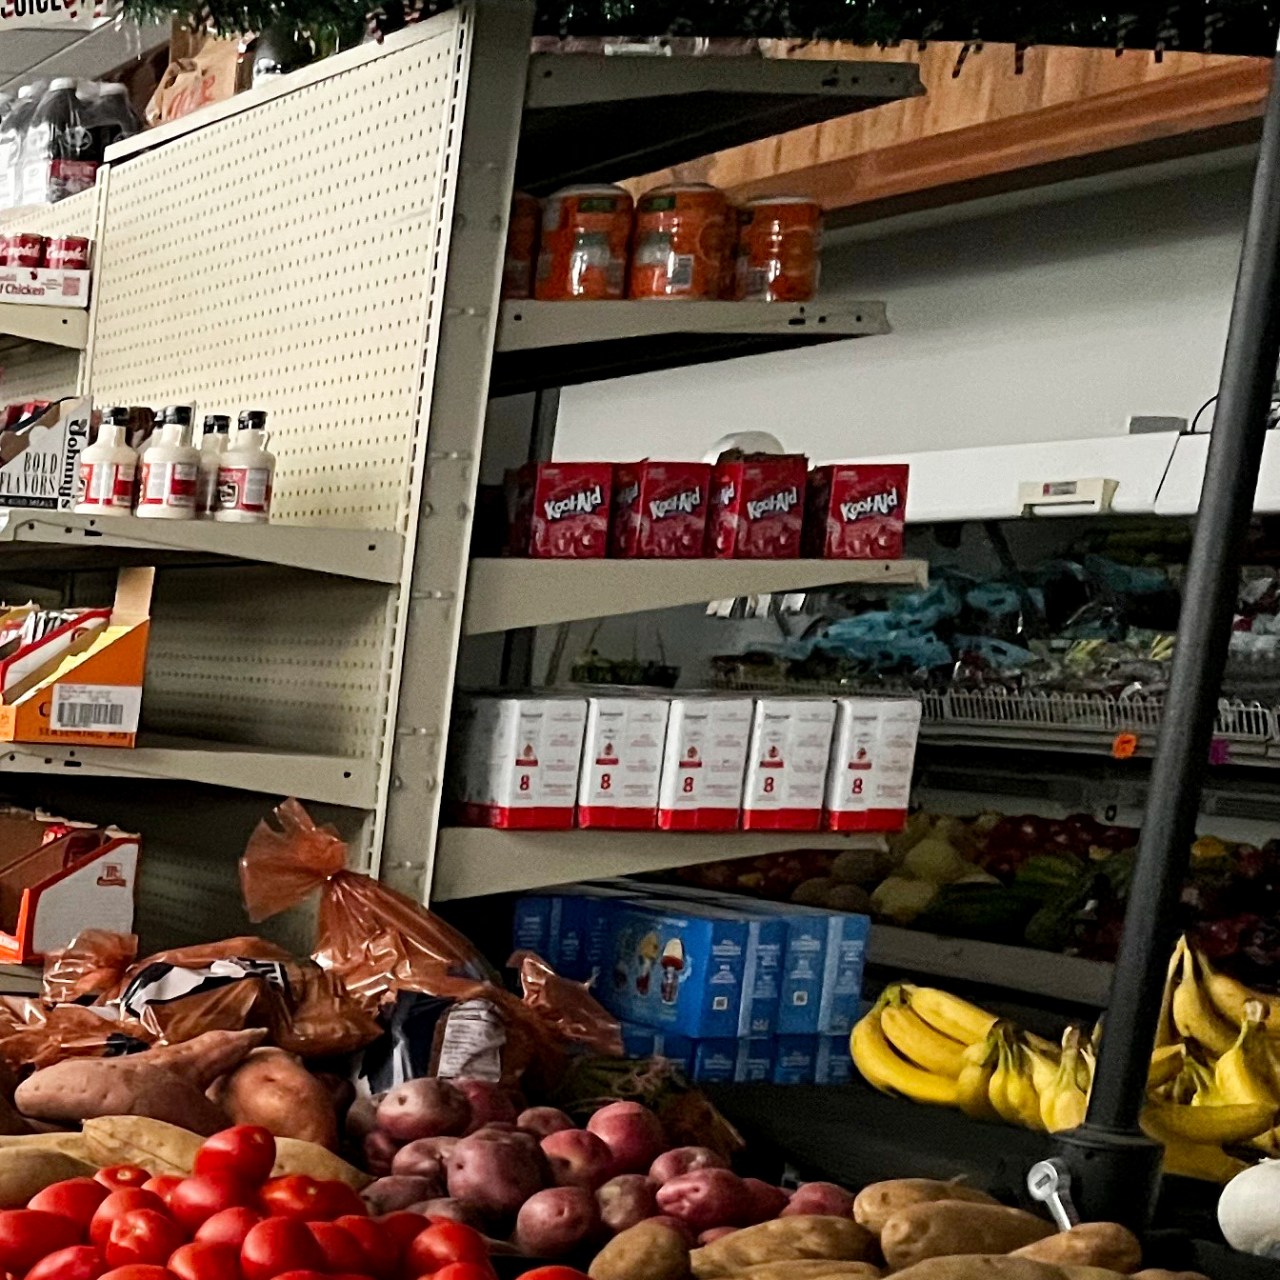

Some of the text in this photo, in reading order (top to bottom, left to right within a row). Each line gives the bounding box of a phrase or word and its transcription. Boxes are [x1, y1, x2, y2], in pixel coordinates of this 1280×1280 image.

[6, 282, 45, 296] Chicken
[24, 452, 58, 474] BOLD
[59, 418, 89, 511] Johnny's
[544, 486, 602, 520] Kool-Aid
[649, 487, 701, 519] Kool-Aid
[747, 486, 798, 520] Kool-Aid
[840, 487, 898, 522] Kool-Aid
[520, 774, 530, 792] 8
[600, 773, 611, 791] 8
[682, 776, 694, 794] 8
[763, 775, 774, 793] 8
[852, 777, 863, 794] 8
